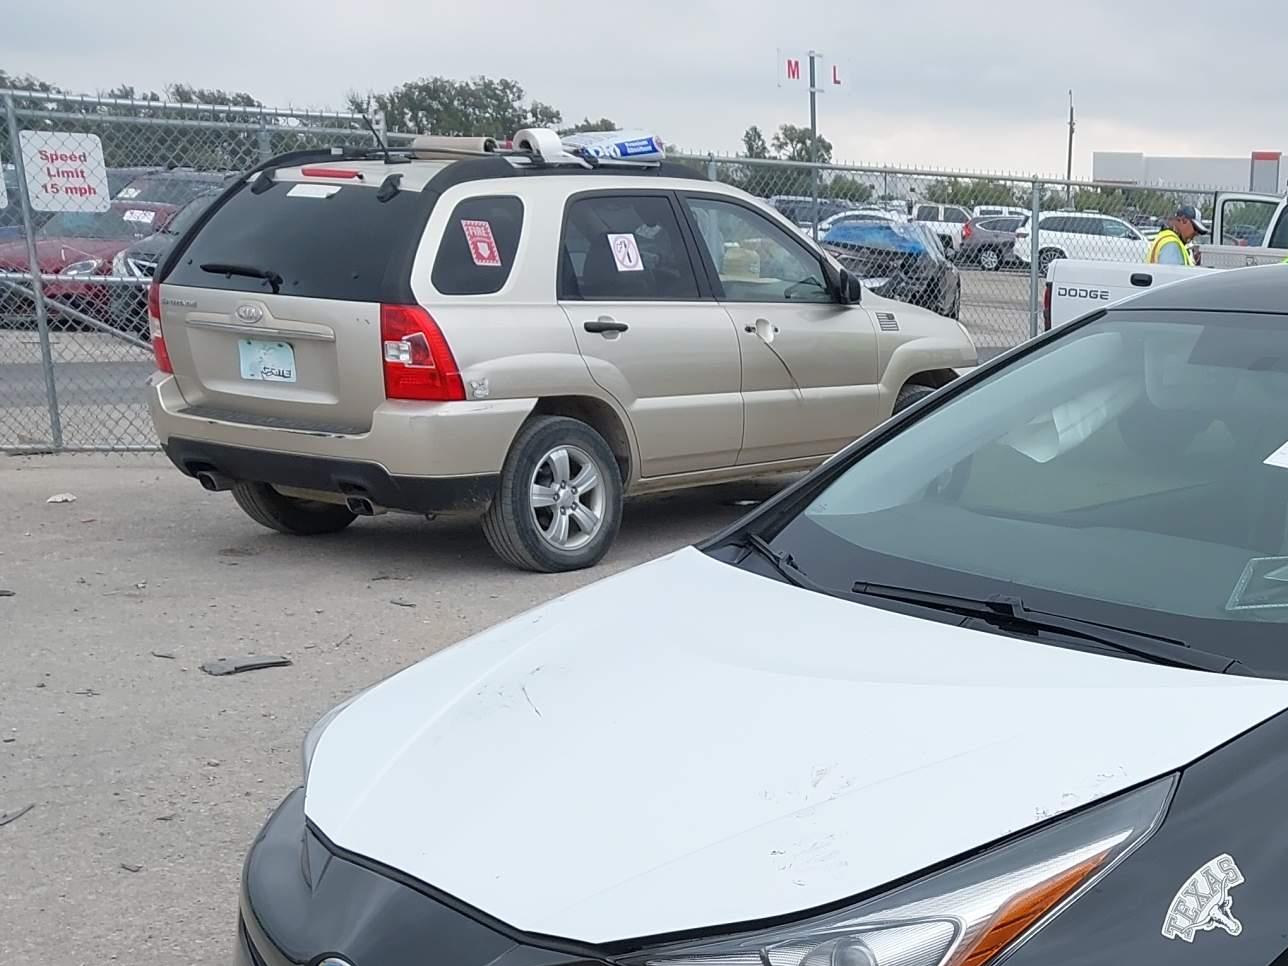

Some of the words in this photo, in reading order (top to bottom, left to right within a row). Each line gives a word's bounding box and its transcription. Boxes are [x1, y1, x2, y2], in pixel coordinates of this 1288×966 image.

[787, 59, 800, 80] M
[833, 65, 841, 84] L
[38, 150, 87, 164] Speed
[47, 167, 86, 180] Limit
[42, 183, 60, 194] 15
[64, 184, 97, 197] mph
[1057, 287, 1109, 300] DODGE
[1164, 857, 1238, 940] TEXAS
